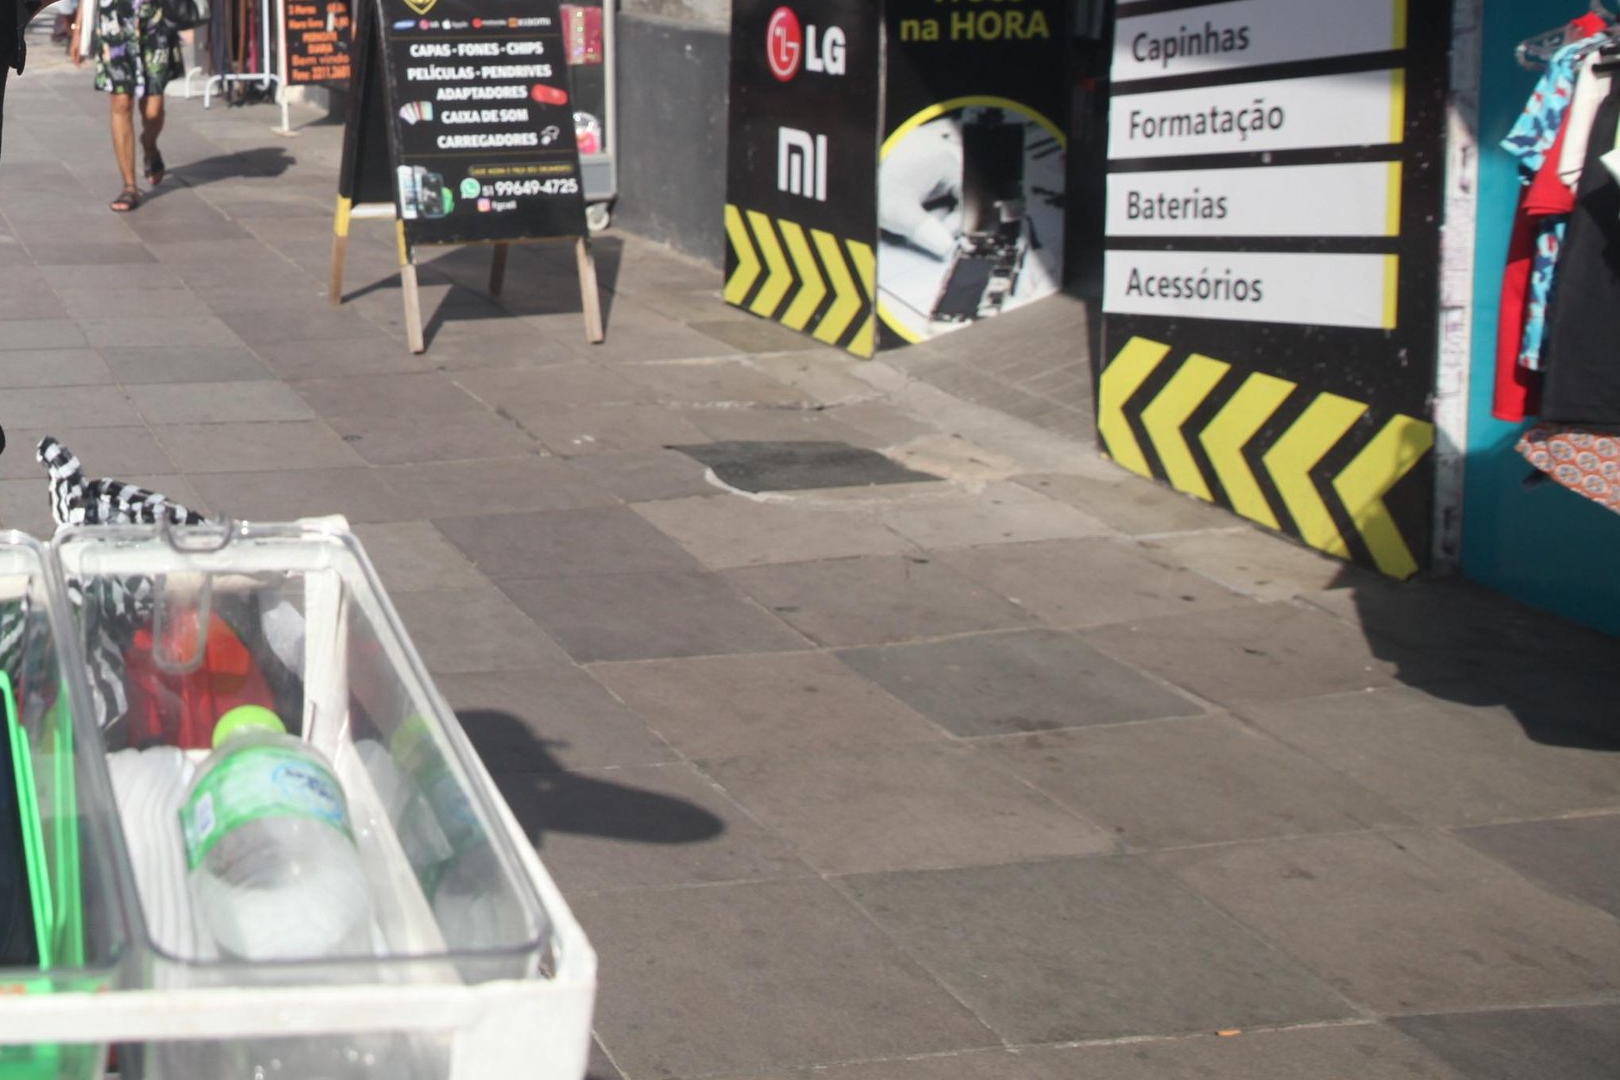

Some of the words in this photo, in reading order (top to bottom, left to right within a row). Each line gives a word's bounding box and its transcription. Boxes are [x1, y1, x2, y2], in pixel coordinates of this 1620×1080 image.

[899, 18, 940, 41] na
[949, 9, 1050, 40] HORA
[409, 43, 451, 58] CAPAS
[458, 42, 500, 57] FONES
[506, 41, 544, 55] CHIPS
[804, 24, 846, 76] LG
[1131, 21, 1250, 68] Capinhas
[407, 64, 475, 81] PELÍCULAS
[482, 64, 553, 79] PENDRIVES
[436, 85, 529, 101] ADAPTADORES
[441, 110, 480, 124] CAIXA
[481, 110, 498, 123] DE
[499, 108, 529, 122] SOM
[1129, 97, 1285, 142] Formatação
[437, 132, 538, 149] CARREGADORES
[495, 178, 579, 197] 99649-4725
[1127, 189, 1228, 221] Baterias
[1125, 266, 1263, 304] Acessórios
